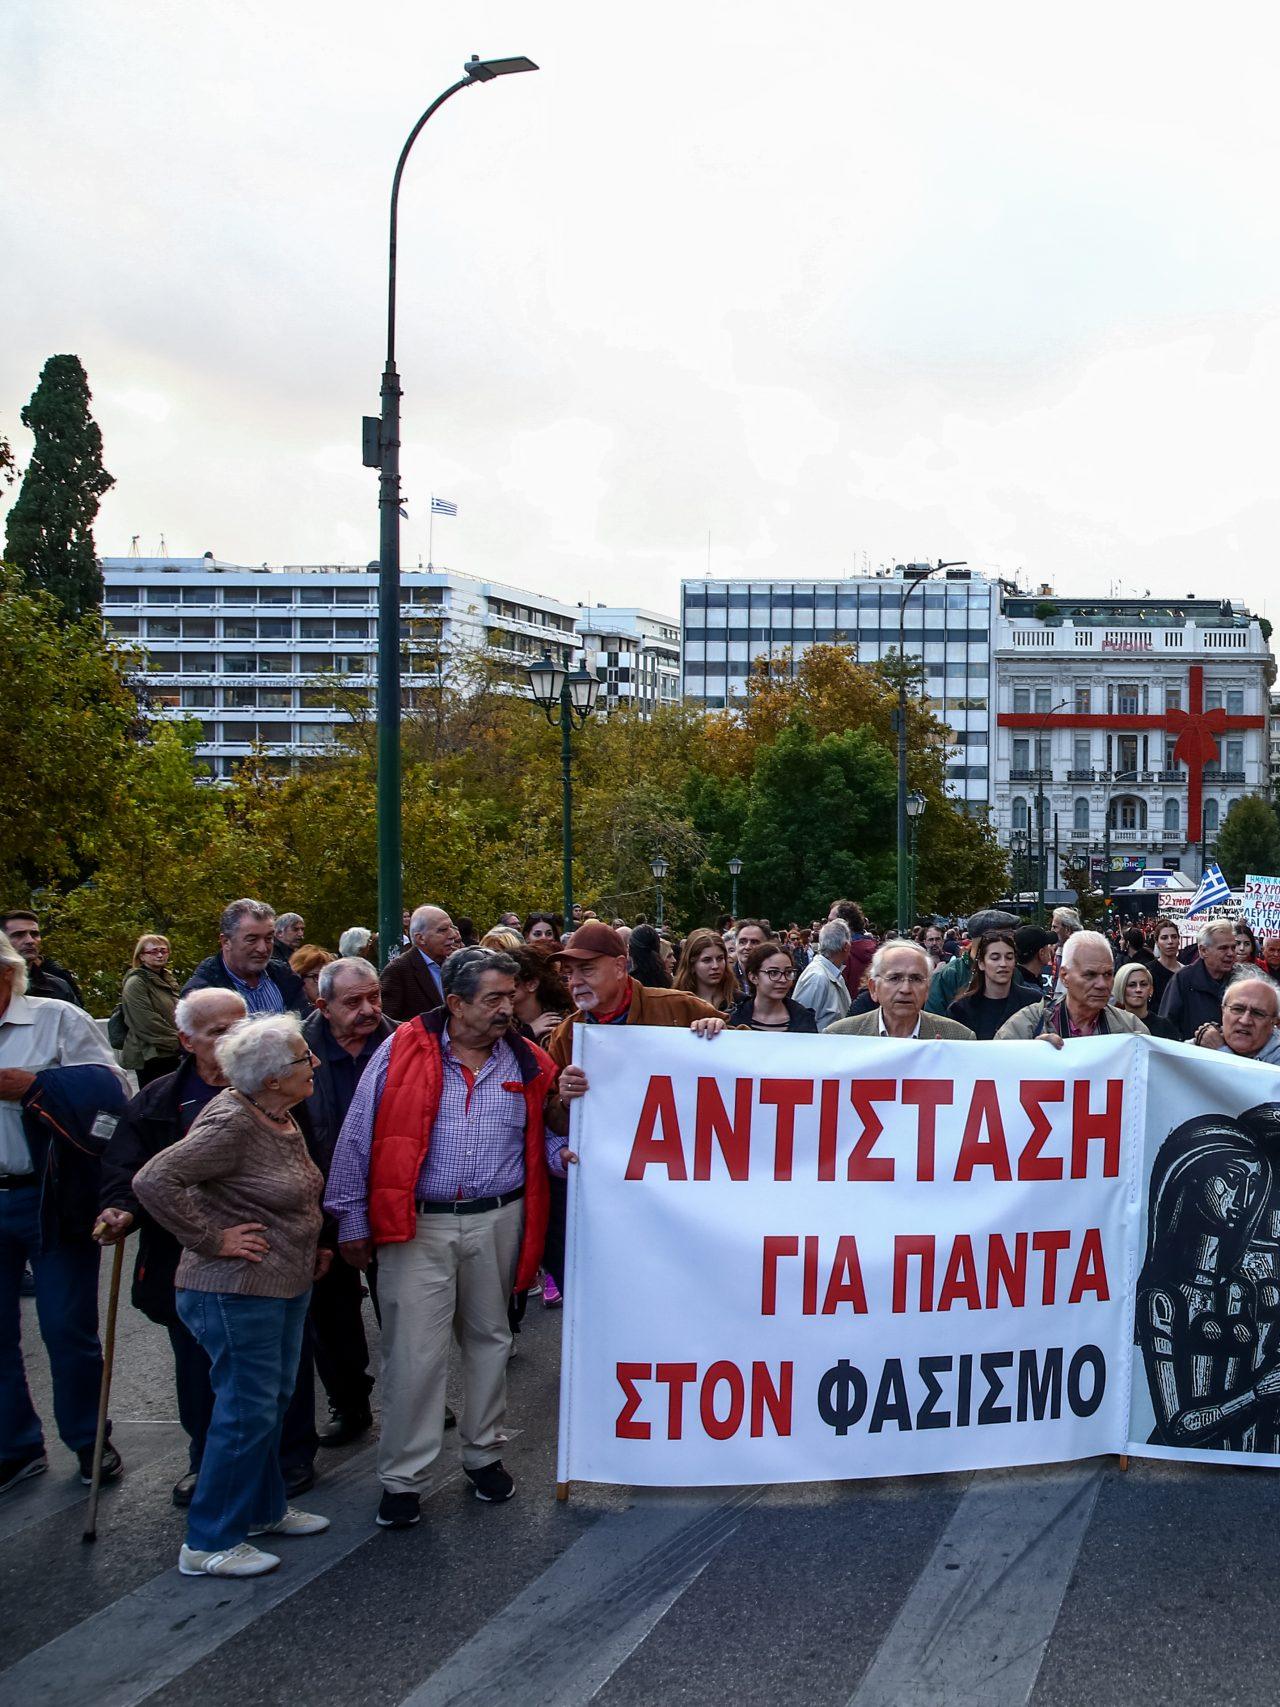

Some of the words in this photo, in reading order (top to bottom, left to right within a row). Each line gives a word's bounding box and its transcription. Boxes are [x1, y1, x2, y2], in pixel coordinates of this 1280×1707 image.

[1102, 640, 1152, 652] Public
[1159, 894, 1171, 906] 52
[1246, 883, 1261, 894] 52
[624, 1075, 1123, 1181] ΑΝΤΙΣΤΑΣΗ
[761, 1235, 868, 1315] ΓΙΑ
[892, 1228, 1110, 1313] ΠΑΝΤΑ
[615, 1360, 793, 1440] ΣΤΟΝ
[817, 1344, 1106, 1436] ΦΑΣΙΣΜΟ
